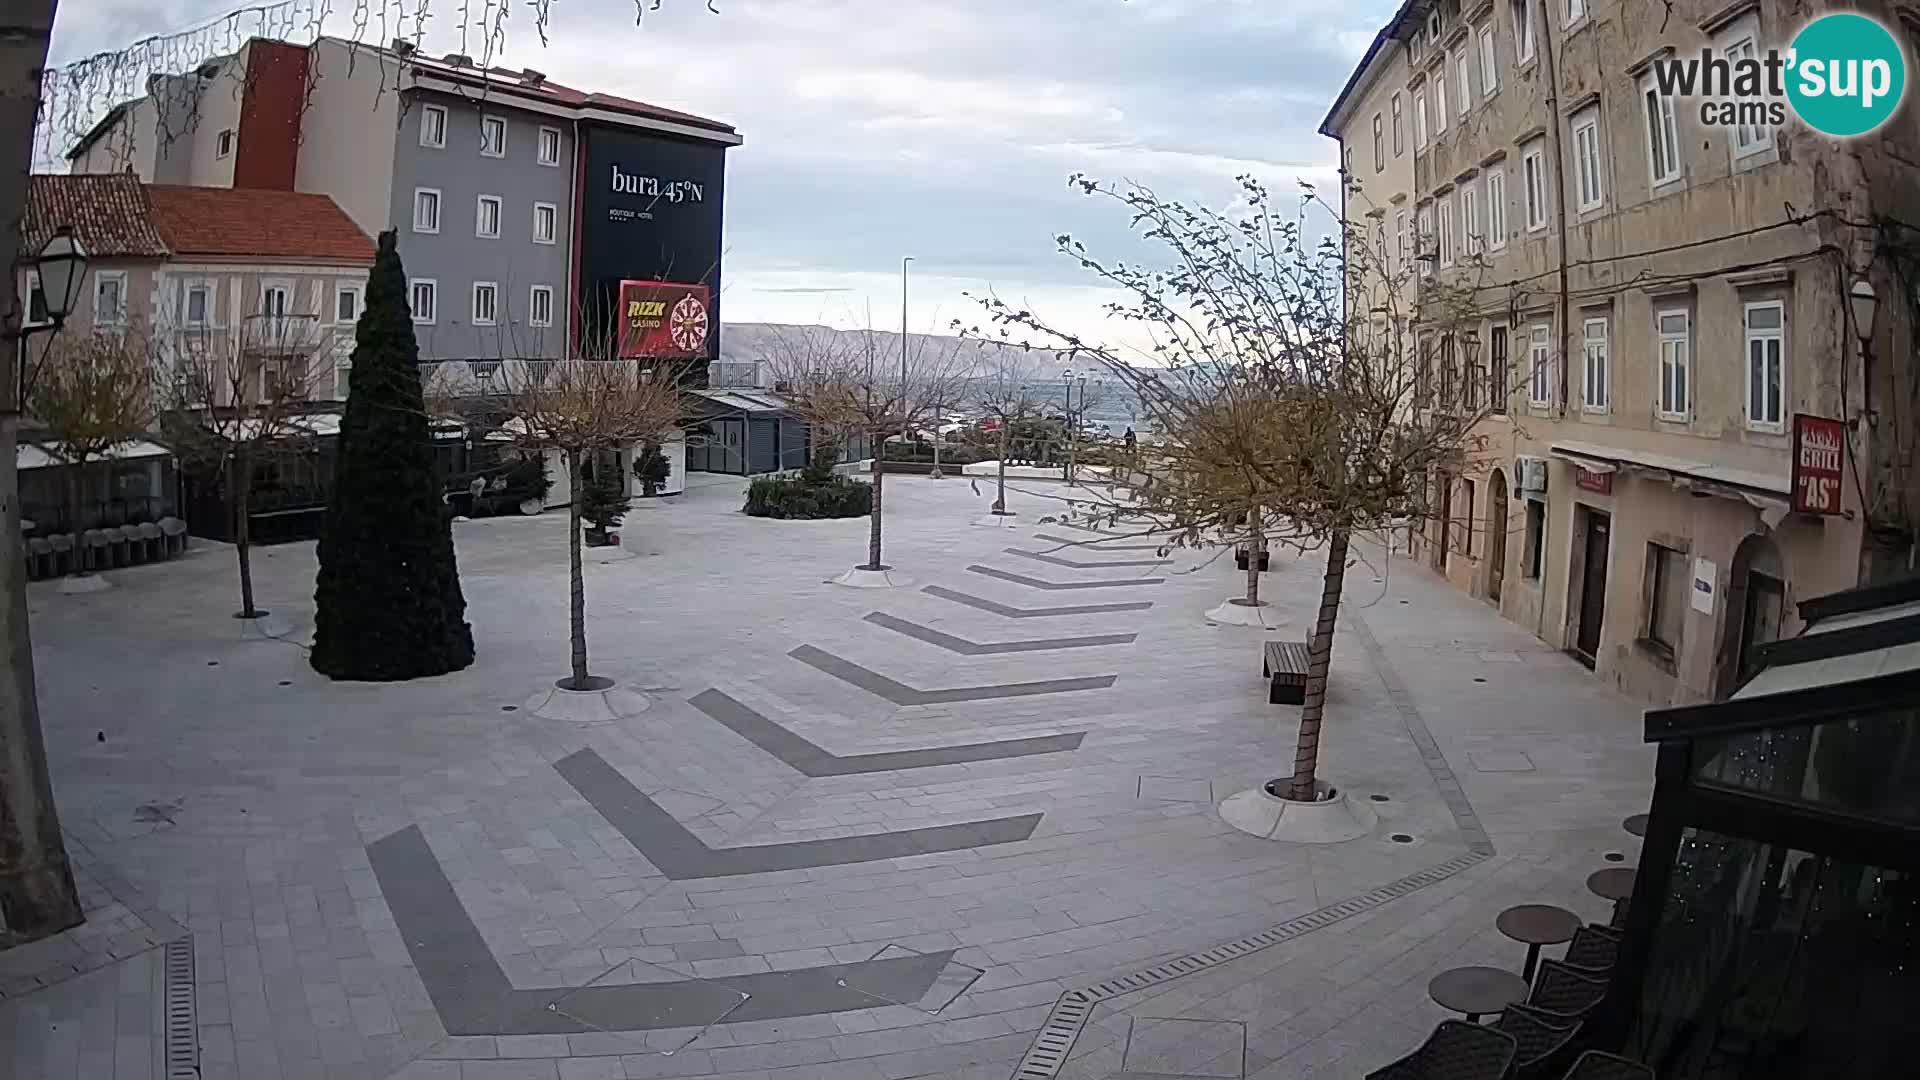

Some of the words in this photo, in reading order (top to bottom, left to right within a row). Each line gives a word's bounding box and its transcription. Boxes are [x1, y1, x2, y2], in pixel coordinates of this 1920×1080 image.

[612, 165, 658, 196] bura
[627, 300, 667, 317] RIZK
[631, 319, 661, 328] CASINO
[1800, 447, 1840, 471] GRILL
